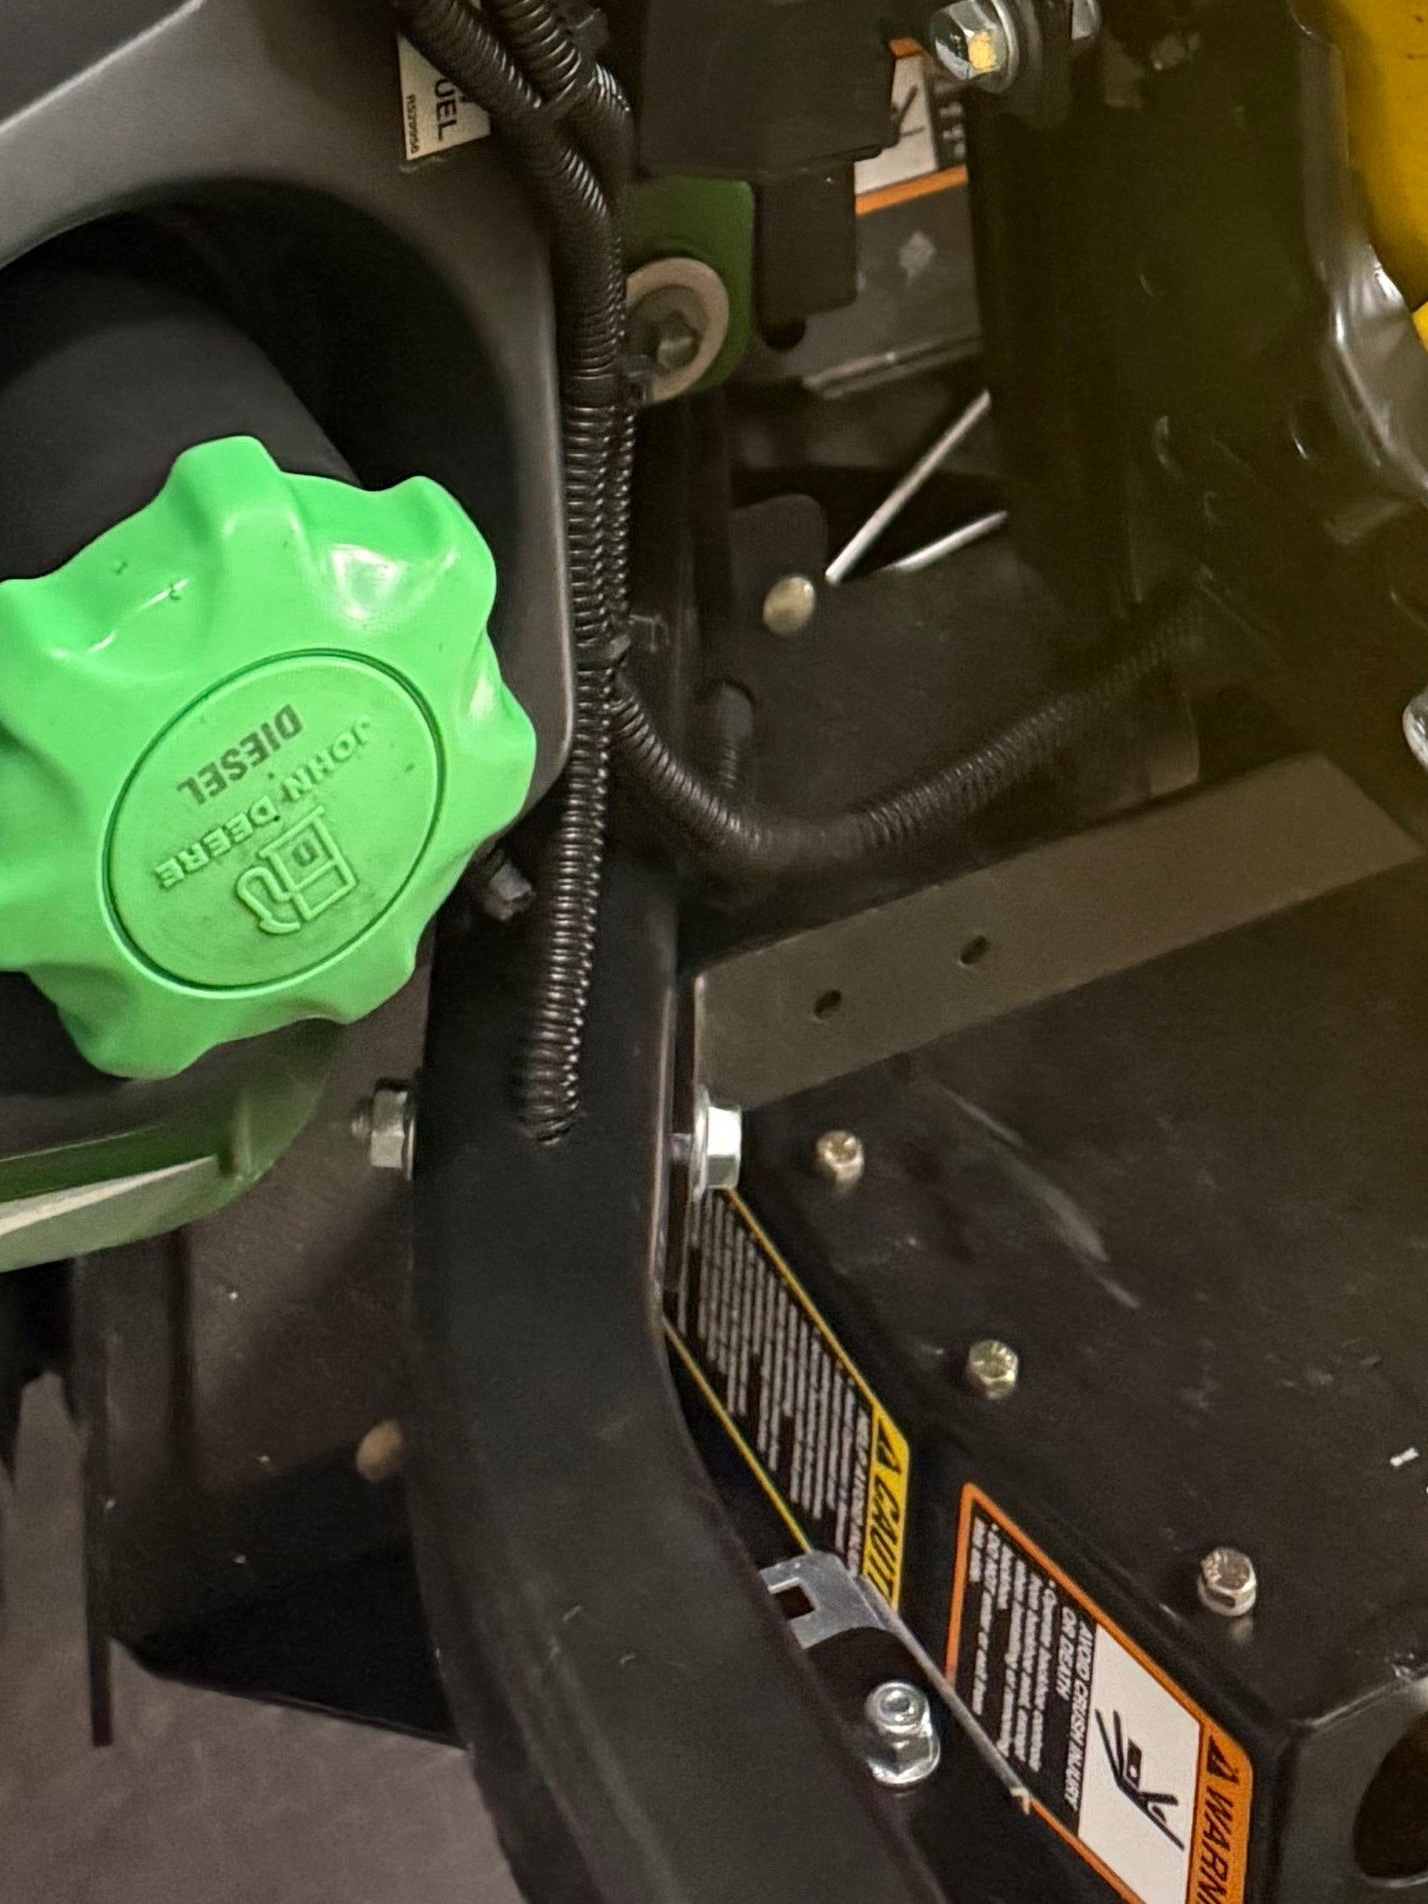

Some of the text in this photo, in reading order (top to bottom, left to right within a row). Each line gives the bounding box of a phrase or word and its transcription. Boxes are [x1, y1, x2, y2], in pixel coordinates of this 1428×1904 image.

[433, 78, 457, 141] UEL
[154, 715, 371, 890] JOHN DEERE
[176, 703, 303, 805] DIESEL
[867, 1474, 902, 1607] CAUT
[984, 1557, 998, 1595] NOT
[987, 1531, 1001, 1560] DO
[1056, 1606, 1077, 1701] OR DEATH
[1064, 1621, 1093, 1812] AVOID CRUSH INJURY
[1196, 1785, 1233, 1904] WARN
